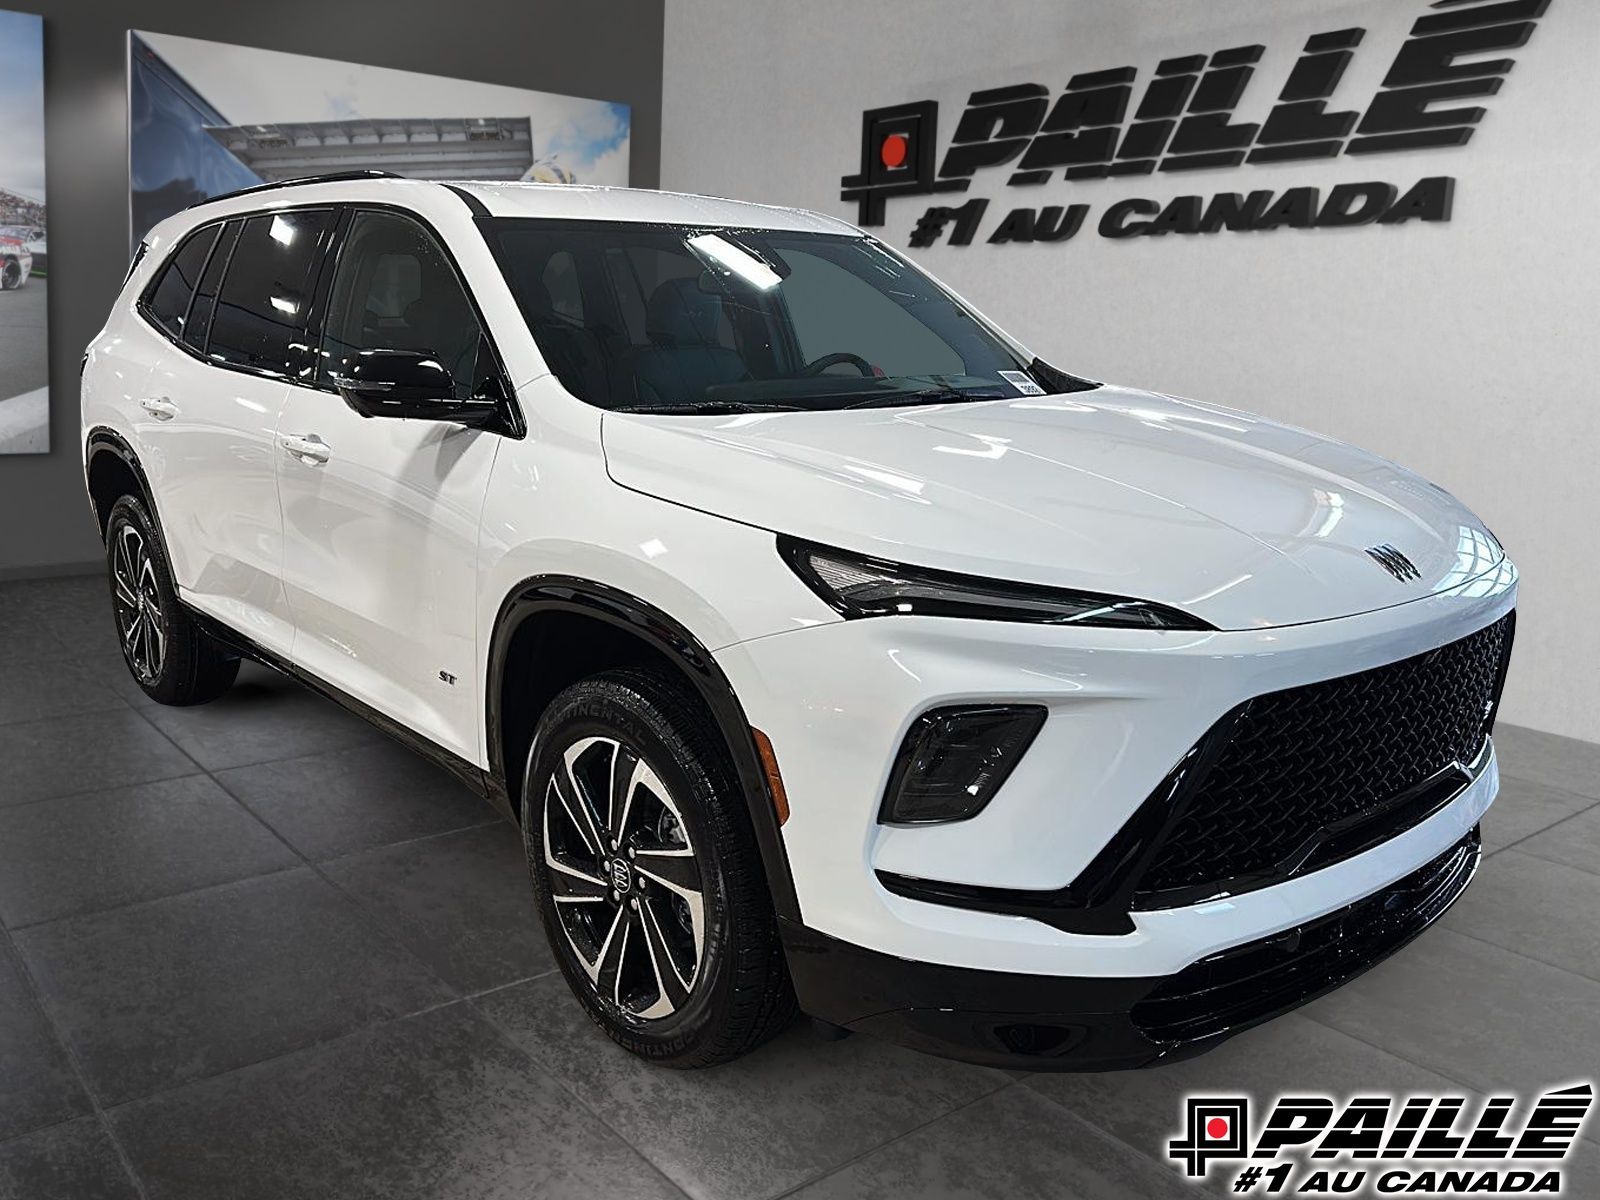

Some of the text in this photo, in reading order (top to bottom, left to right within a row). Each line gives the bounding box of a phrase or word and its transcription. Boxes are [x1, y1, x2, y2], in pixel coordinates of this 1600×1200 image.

[908, 176, 1456, 248] #1 AU CANADA
[438, 670, 458, 686] ST
